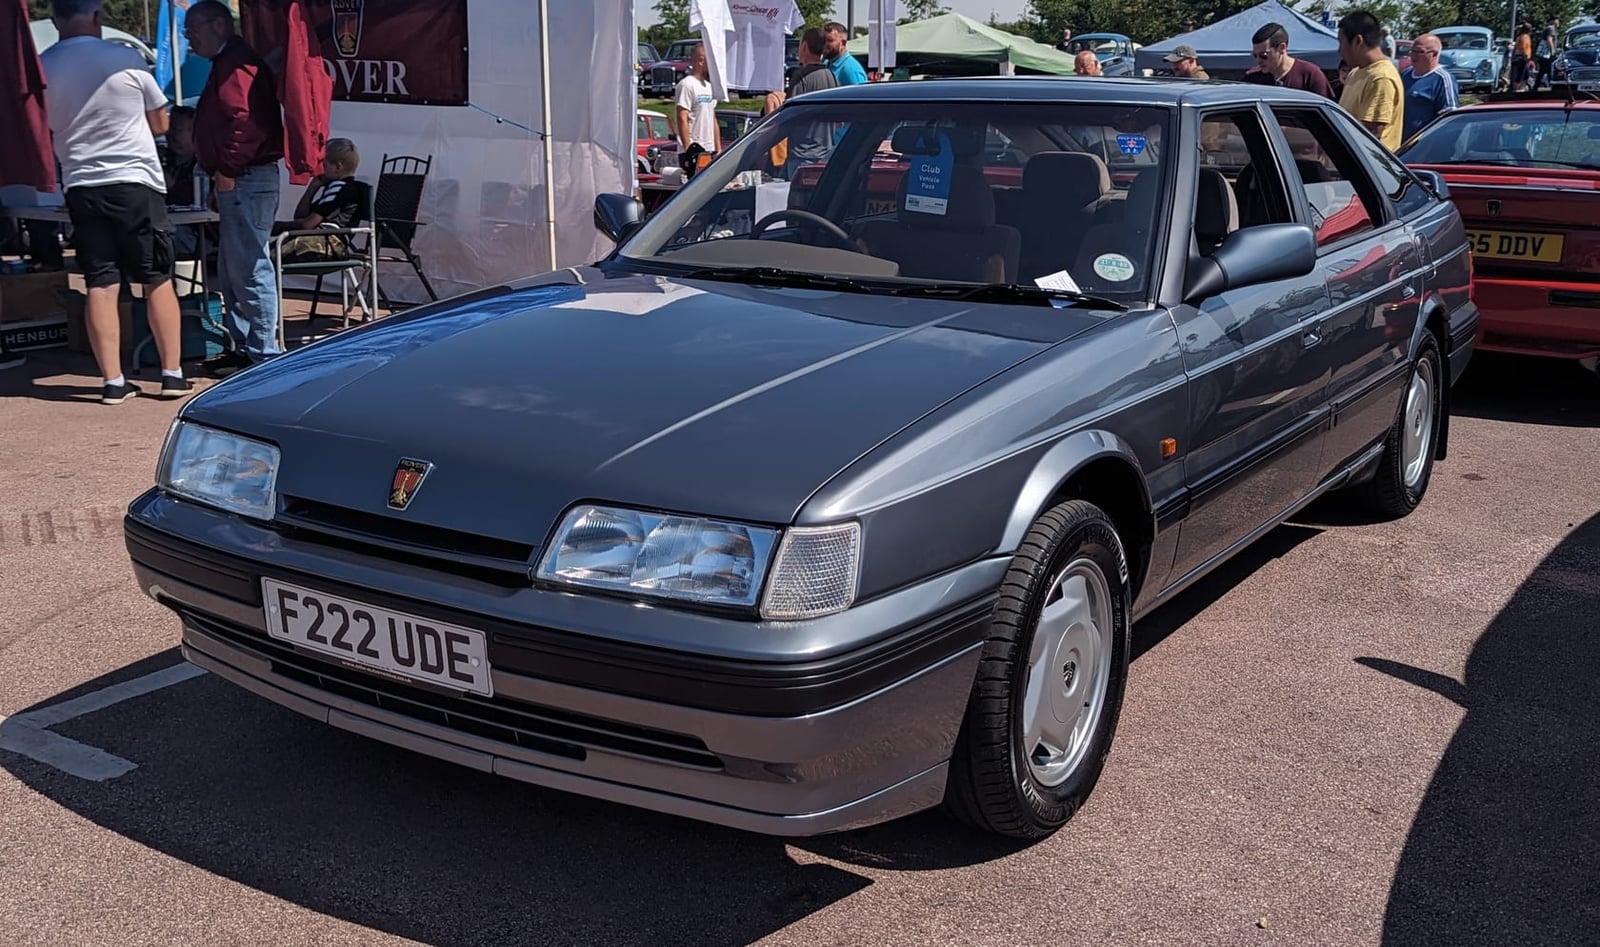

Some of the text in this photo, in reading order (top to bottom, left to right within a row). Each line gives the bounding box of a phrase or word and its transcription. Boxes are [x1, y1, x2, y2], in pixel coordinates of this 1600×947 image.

[920, 163, 941, 174] Club
[919, 175, 940, 183] Vehicle
[921, 182, 936, 190] Pass
[1497, 235, 1545, 257] DDV
[277, 588, 475, 684] F222 UDE
